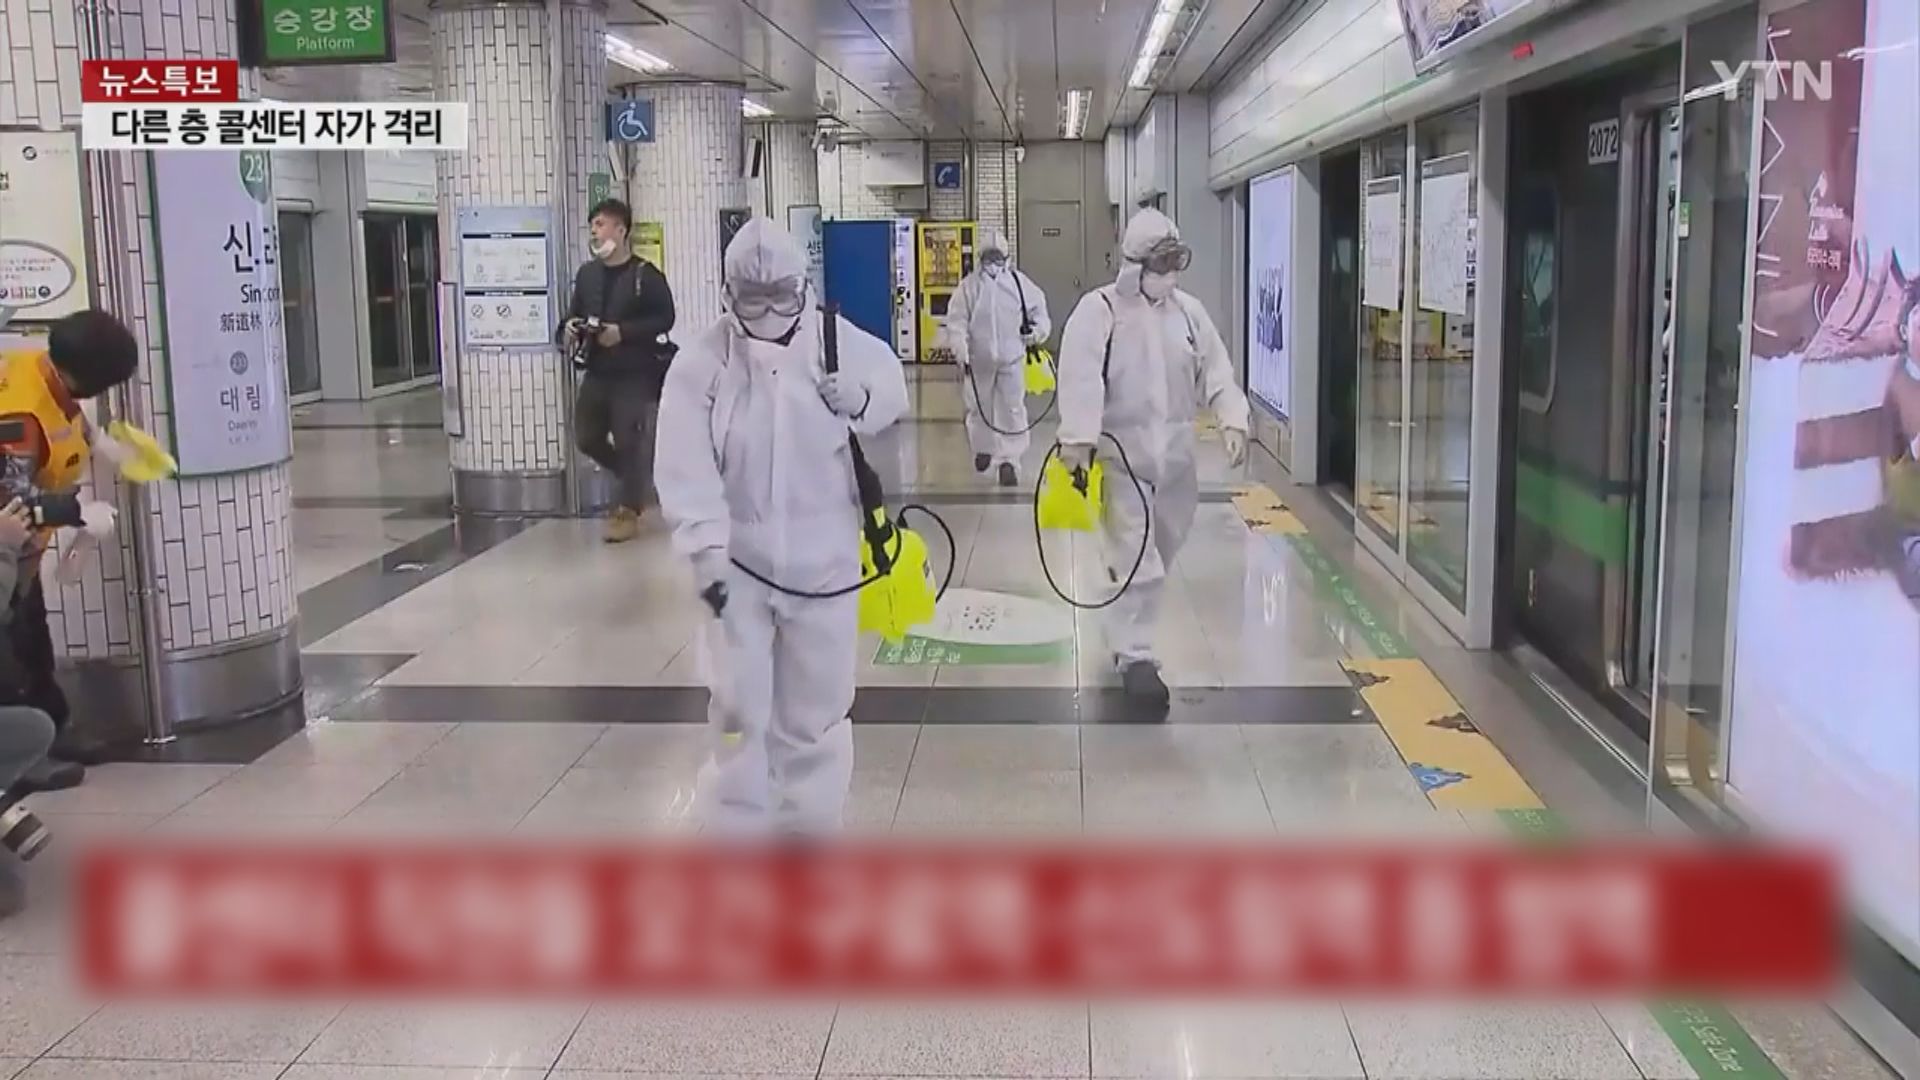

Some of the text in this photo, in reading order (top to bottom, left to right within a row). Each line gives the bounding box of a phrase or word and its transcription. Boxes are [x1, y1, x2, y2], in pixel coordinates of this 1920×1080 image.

[273, 5, 375, 33] 승강장
[296, 36, 355, 50] Platform
[1590, 125, 1618, 157] 2072
[220, 384, 260, 412] 대림
